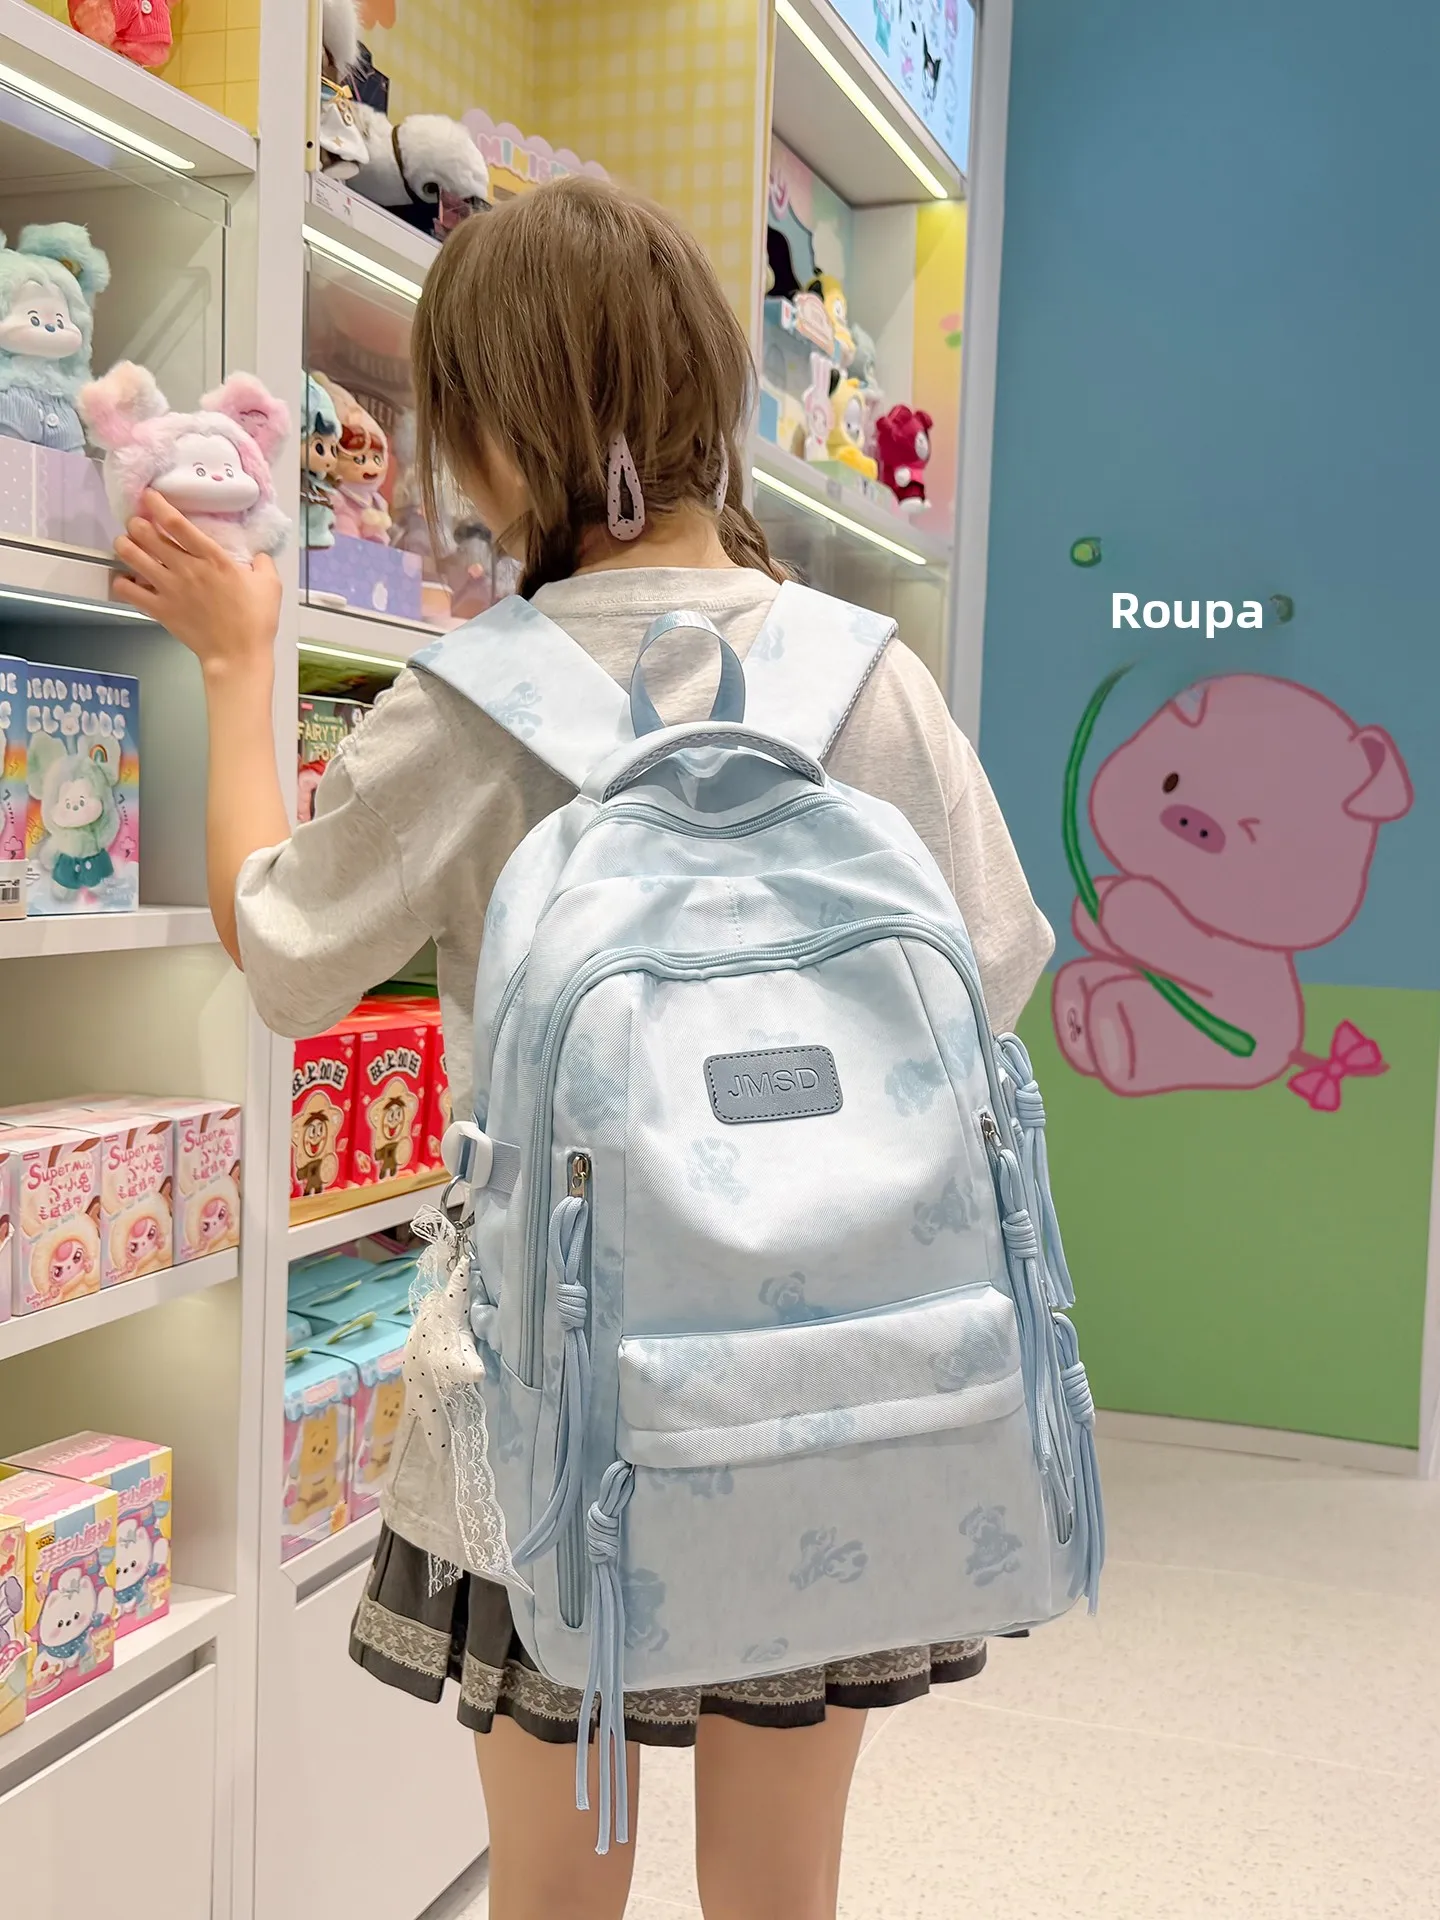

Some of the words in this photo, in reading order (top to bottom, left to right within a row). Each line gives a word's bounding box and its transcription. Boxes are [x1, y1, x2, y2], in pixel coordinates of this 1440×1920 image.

[72, 682, 93, 702] IN
[96, 685, 131, 708] THE
[298, 720, 329, 742] FAIRY
[728, 1067, 820, 1098] JMSD
[108, 1145, 144, 1171] Super
[27, 1162, 70, 1190] Super
